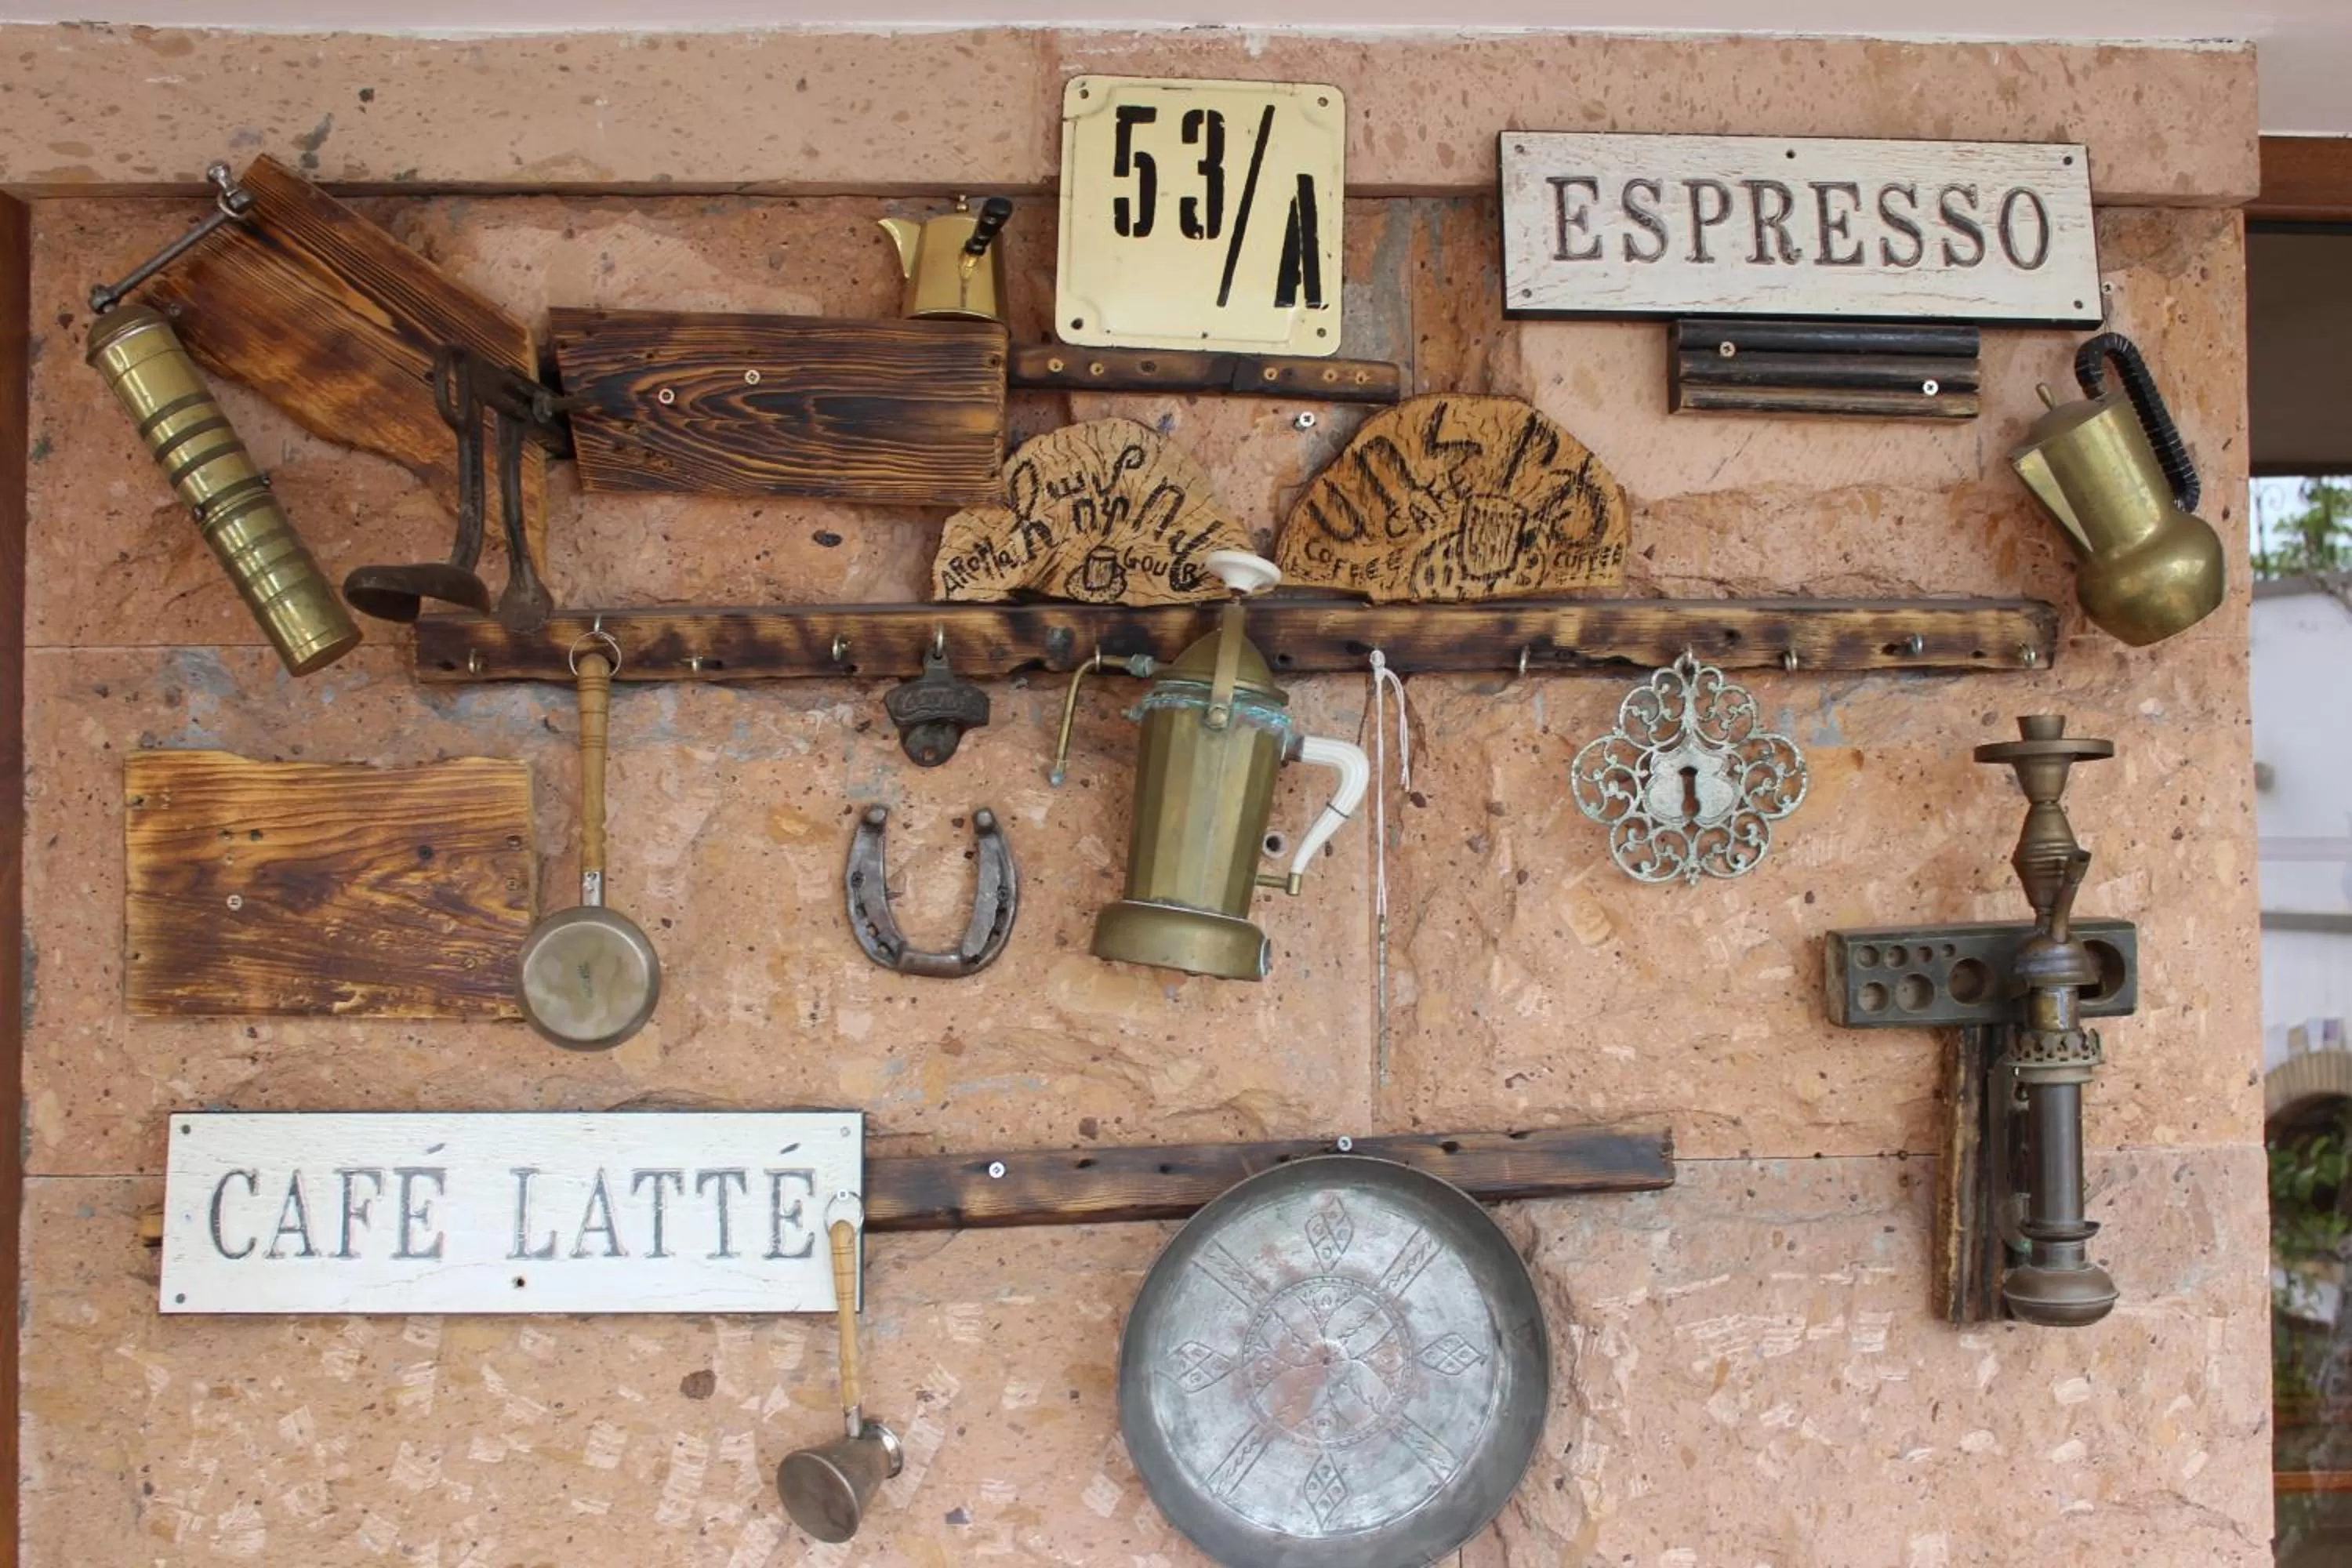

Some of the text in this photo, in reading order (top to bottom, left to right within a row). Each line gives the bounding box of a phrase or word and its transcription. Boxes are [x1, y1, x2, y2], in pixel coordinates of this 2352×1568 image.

[1545, 175, 2053, 271] ESPRESSO
[1305, 536, 1406, 587] COFFEE
[207, 1142, 817, 1261] CAFÉ LATTÉ
